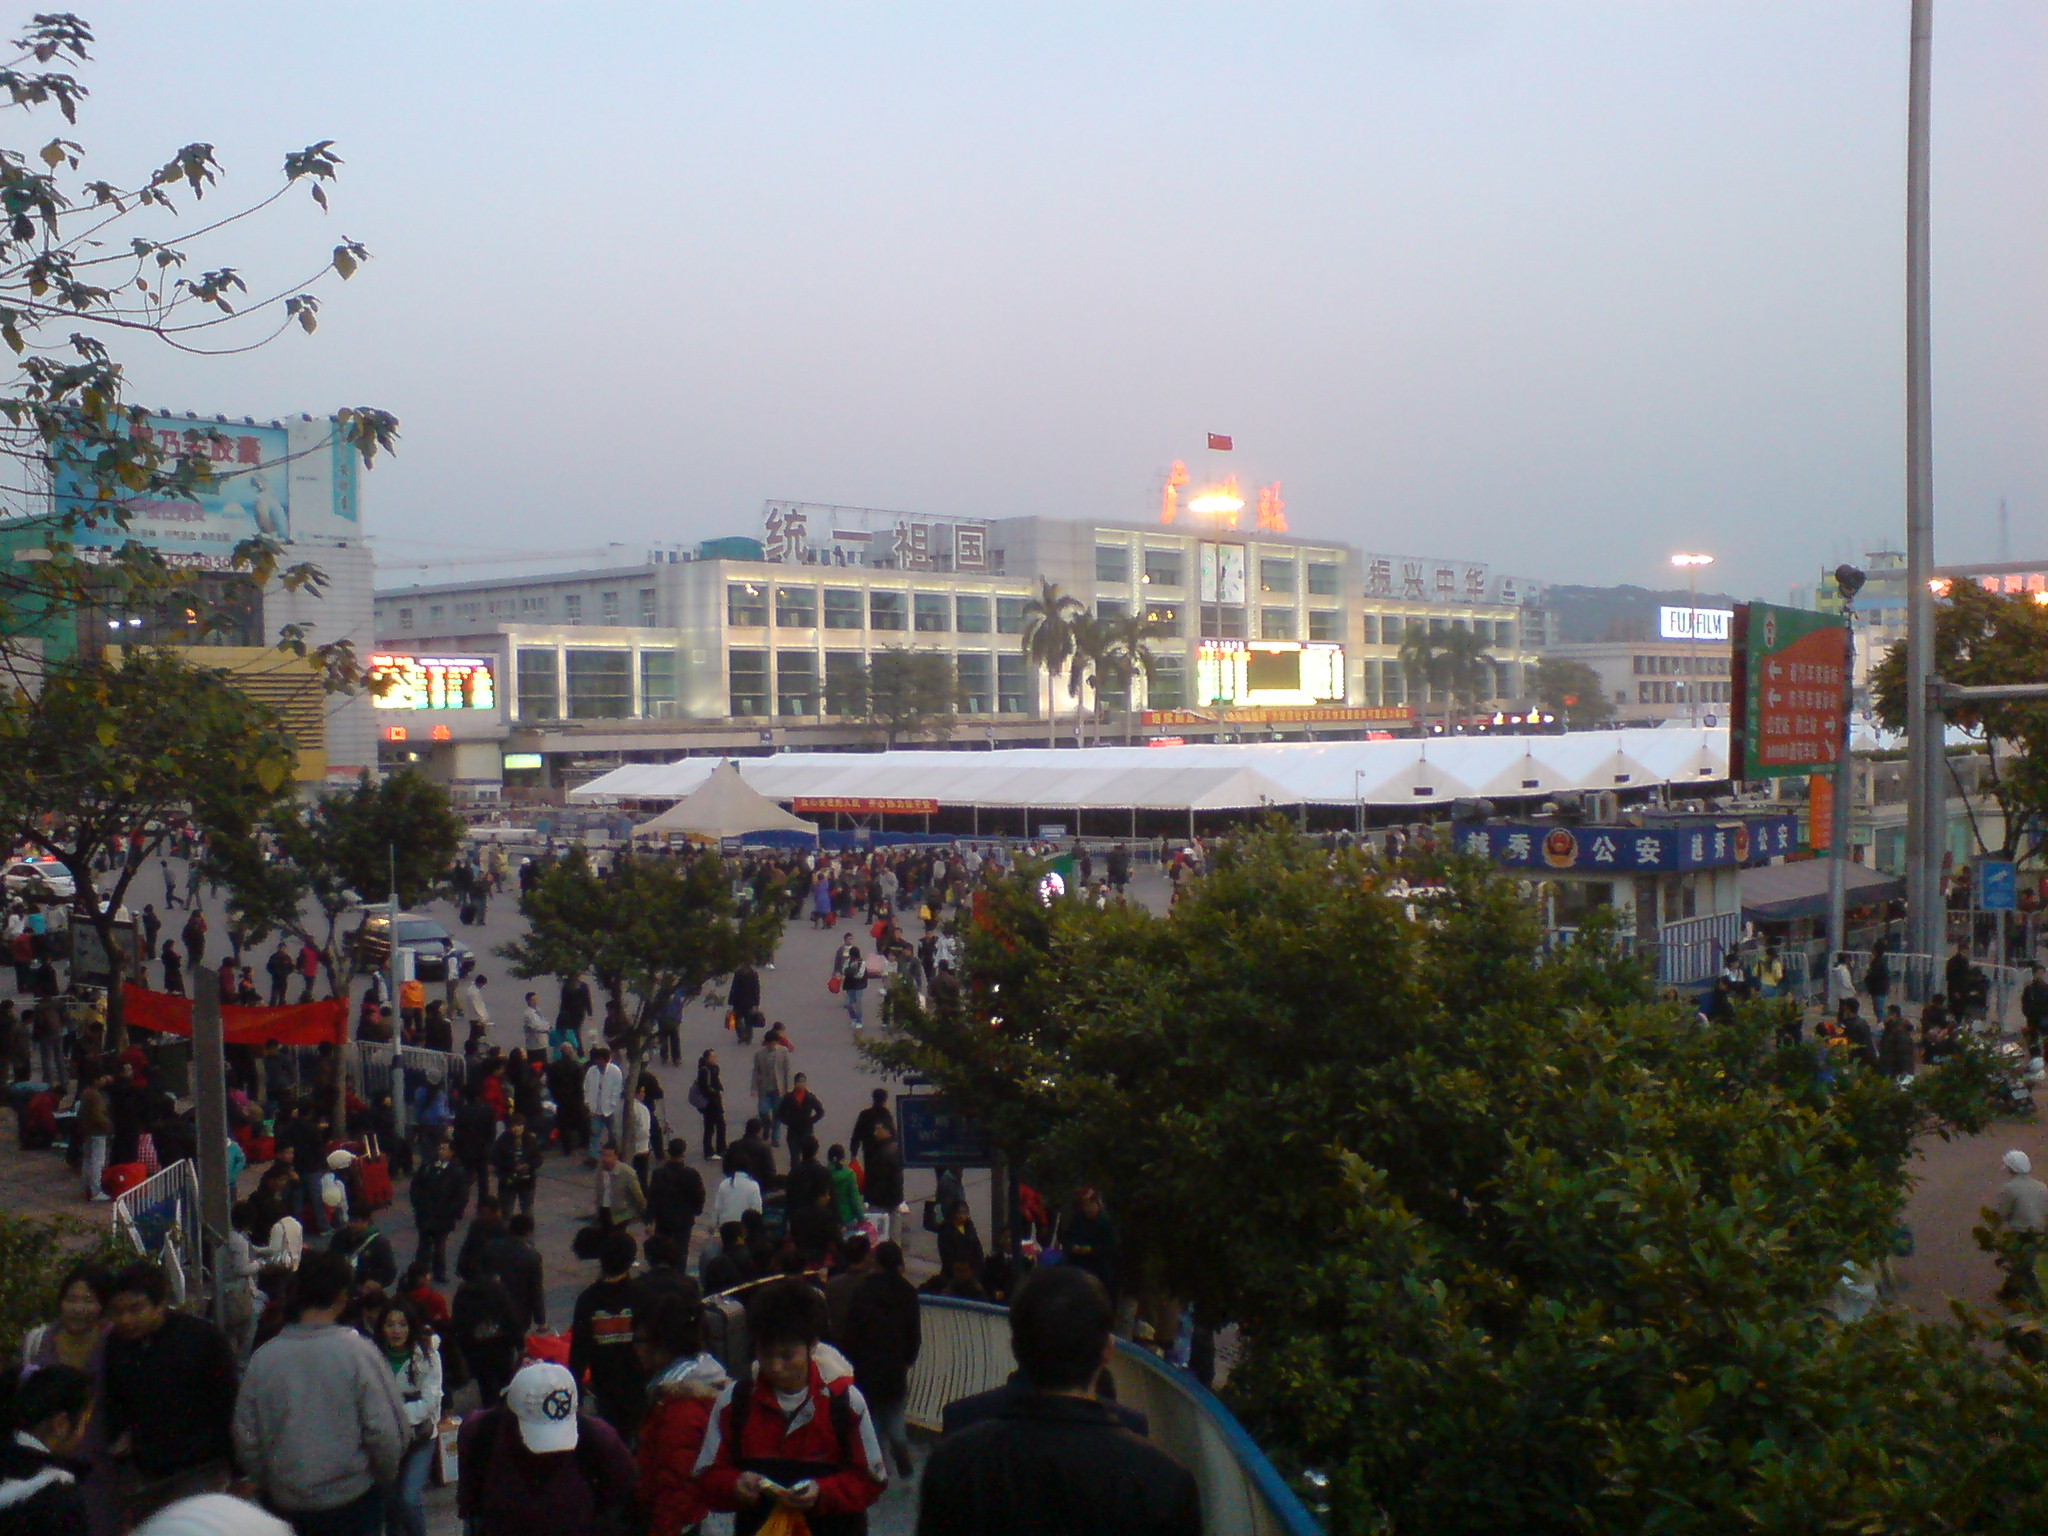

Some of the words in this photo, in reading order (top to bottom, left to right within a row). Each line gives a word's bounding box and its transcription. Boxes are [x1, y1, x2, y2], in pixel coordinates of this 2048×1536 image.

[762, 508, 988, 572] 统一祖国
[1369, 558, 1486, 603] 振兴中华
[1670, 610, 1722, 635] FUJIFILM
